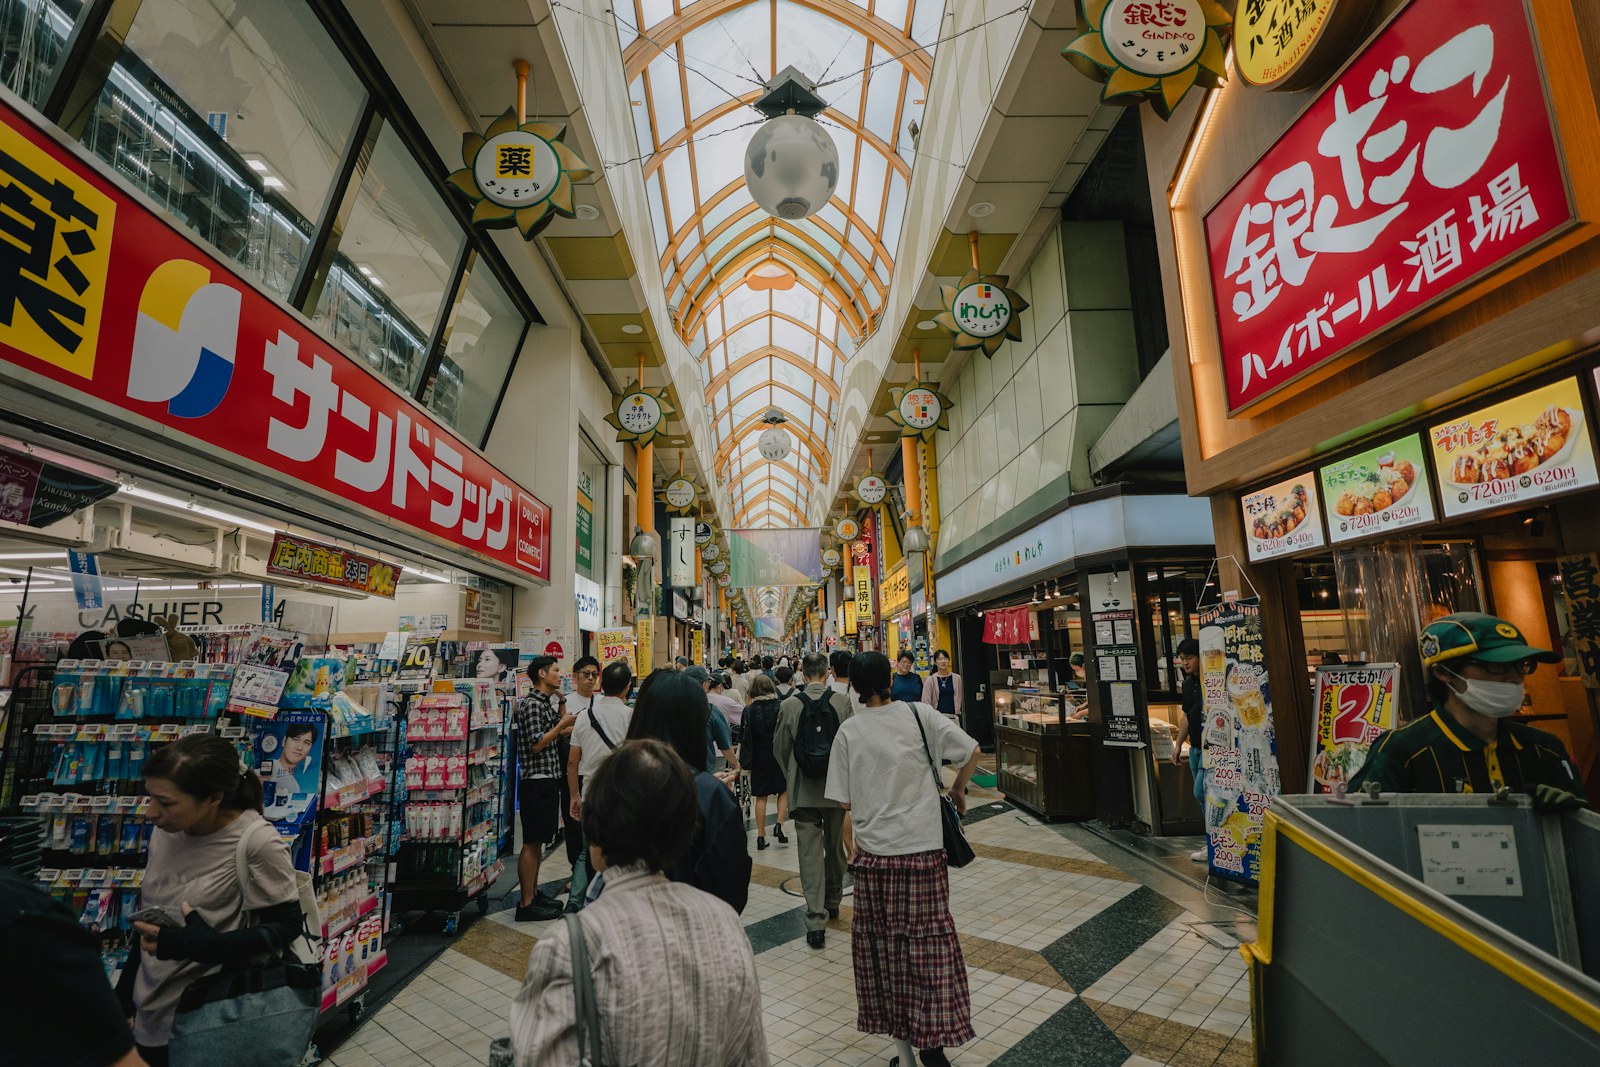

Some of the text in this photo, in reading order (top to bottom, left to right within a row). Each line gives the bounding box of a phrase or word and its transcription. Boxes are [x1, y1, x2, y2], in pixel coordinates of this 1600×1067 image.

[1123, 2, 1187, 28] 銀だこ
[1142, 30, 1195, 41] GINDACO
[1122, 39, 1189, 61] サンモール
[498, 147, 531, 175] 薬
[1223, 23, 1511, 323] 銀だこ
[485, 179, 540, 198] サンモール
[907, 394, 934, 405] 惣菜
[263, 329, 512, 552] サンドラッグ
[1436, 418, 1498, 454] てりたま
[1471, 479, 1516, 500] 720円
[1533, 467, 1576, 486] 620円
[36, 497, 73, 514] Kanebo
[522, 505, 539, 526] DRUG
[1348, 506, 1419, 530] 720円 620円
[528, 527, 533, 539] &
[518, 539, 541, 560] COSMETIC
[673, 523, 691, 566] すし
[273, 540, 344, 579] 店内商品
[346, 558, 369, 586] 本日
[858, 580, 869, 612] 日焼け
[78, 602, 223, 628] CASHIER
[1226, 643, 1264, 663] この価格
[1204, 677, 1225, 688] モルツ
[1207, 690, 1228, 699] 250円
[1322, 689, 1333, 739] 九条ねぎ
[1209, 746, 1242, 757] ジムビーム
[1209, 757, 1242, 768] ハイボール
[1215, 768, 1241, 781] 200円
[1215, 849, 1241, 865] 200円
